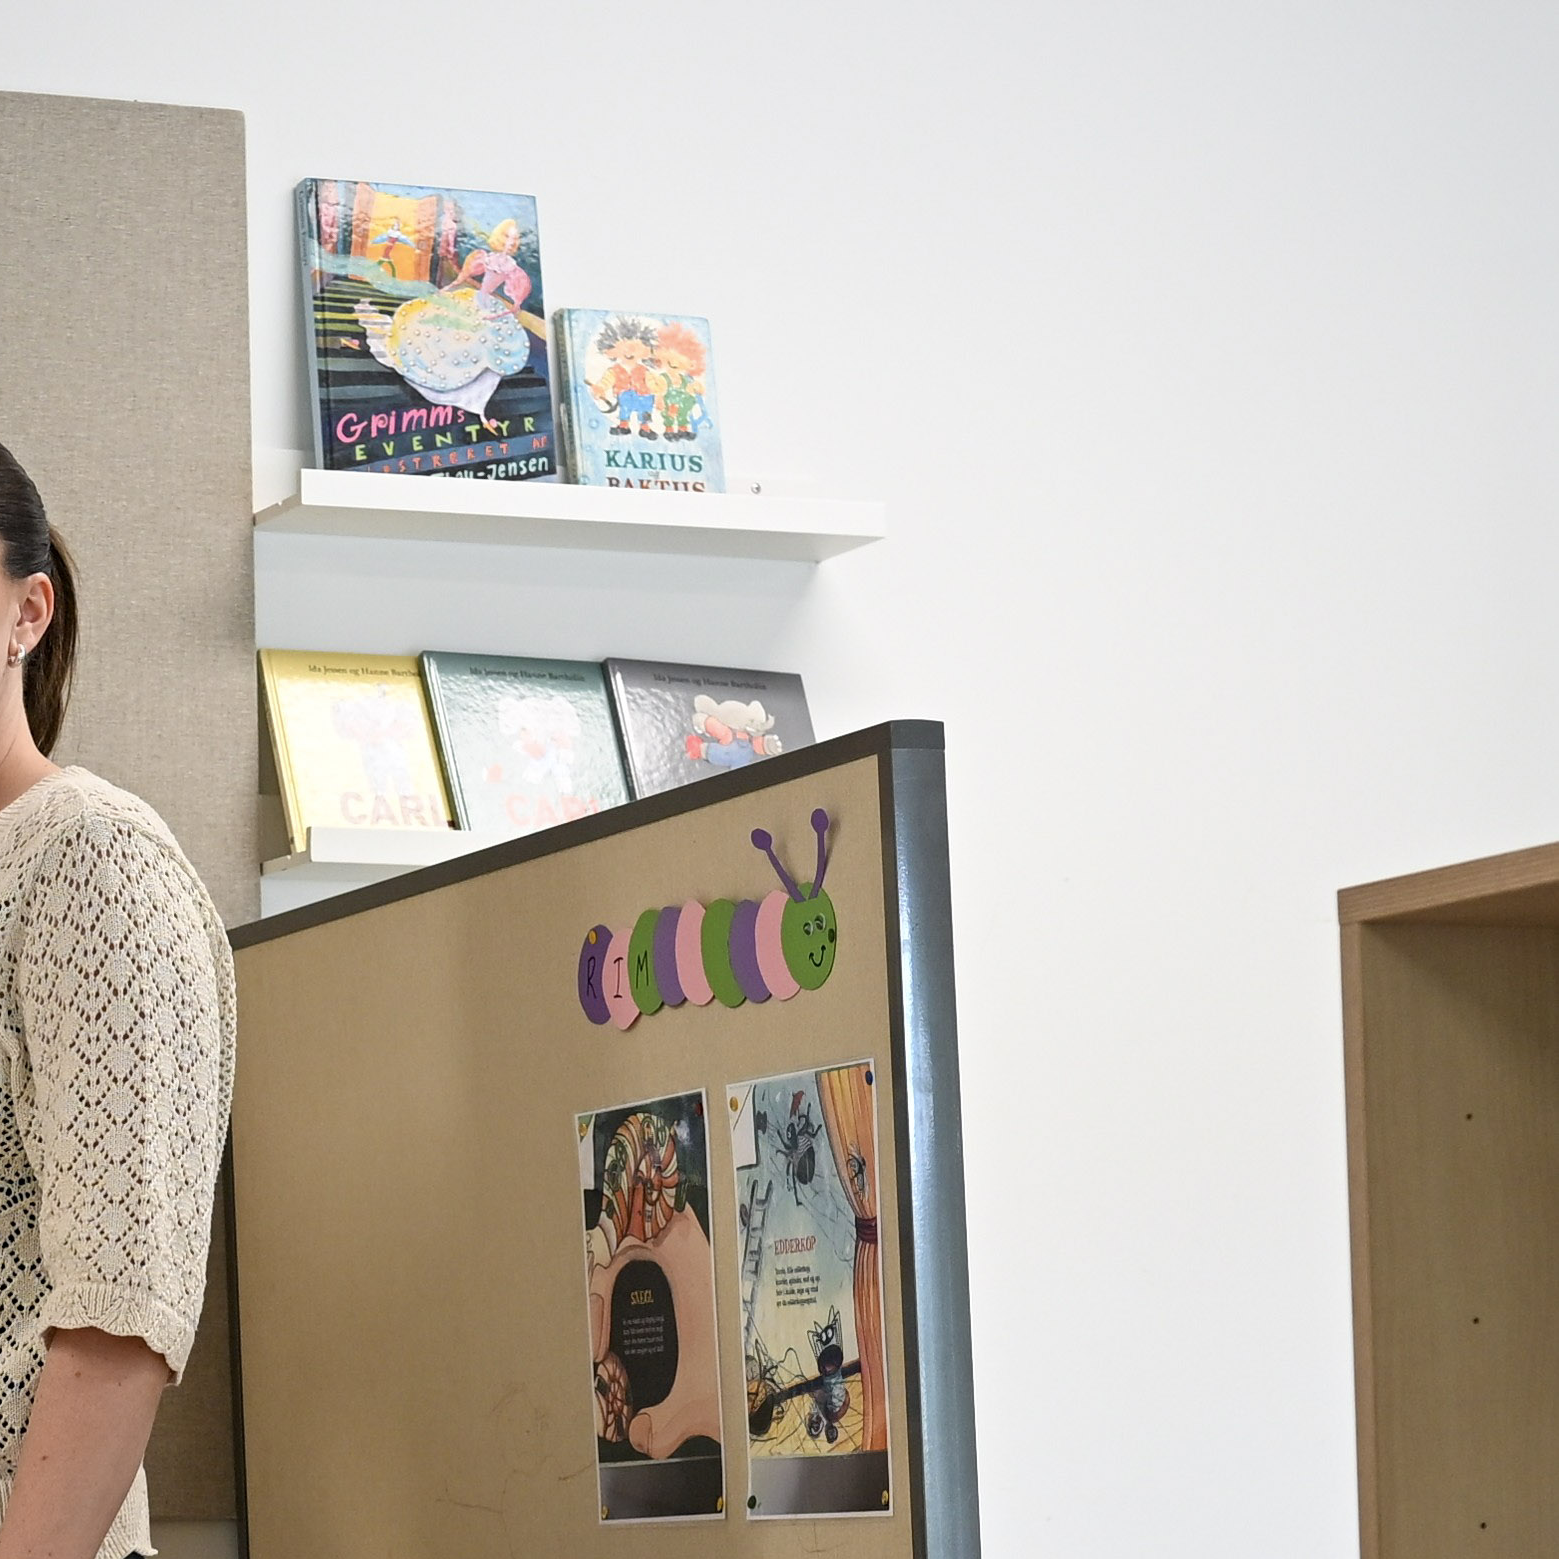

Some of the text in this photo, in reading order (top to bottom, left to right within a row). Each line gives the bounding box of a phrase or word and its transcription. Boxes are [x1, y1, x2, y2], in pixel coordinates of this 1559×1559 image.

[355, 417, 535, 461] EVENTYR
[604, 450, 703, 473] KARIUS
[309, 664, 321, 673] Ida
[349, 668, 360, 676] og
[362, 667, 389, 676] Hanne
[774, 1235, 816, 1256] EDDERKOP
